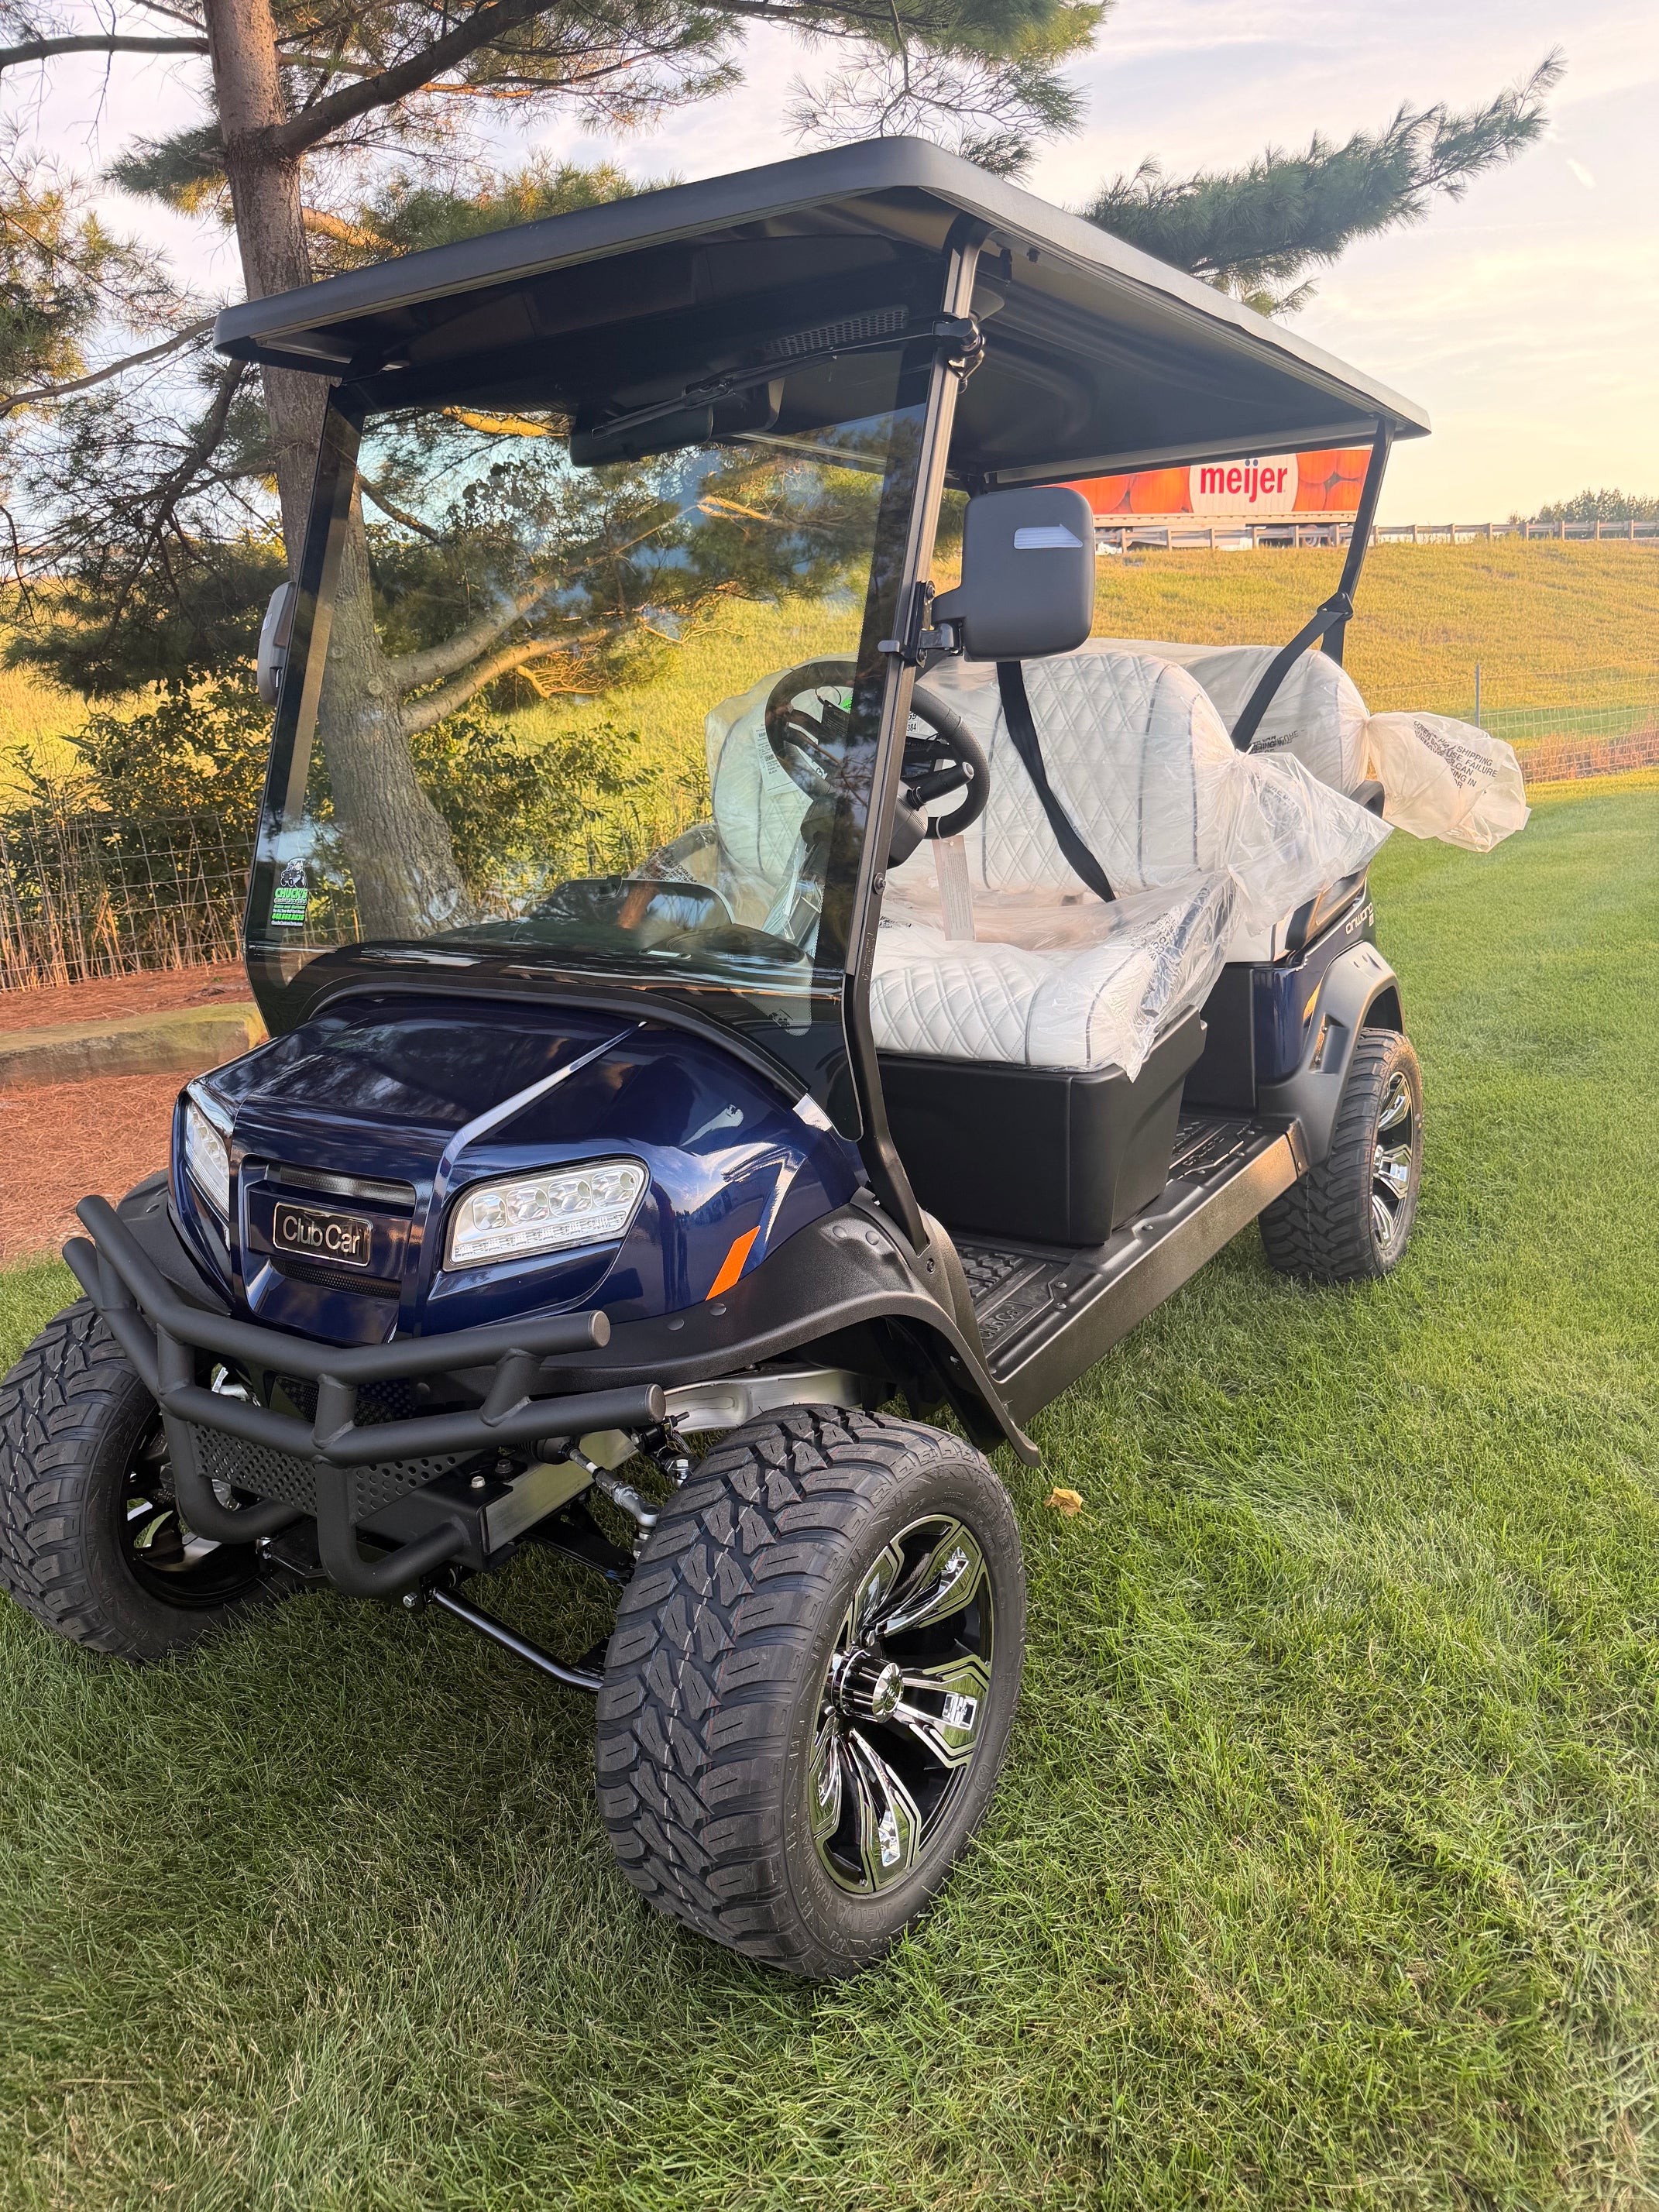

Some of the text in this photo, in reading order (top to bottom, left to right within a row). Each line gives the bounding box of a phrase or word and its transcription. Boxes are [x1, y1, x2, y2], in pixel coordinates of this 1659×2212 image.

[1201, 459, 1288, 503] meijer
[1456, 745, 1493, 767] SHIPPING
[1456, 762, 1474, 776] CAN
[1465, 759, 1499, 778] FAILURE
[1467, 778, 1477, 788] IN
[275, 887, 308, 899] CHUCK'S
[283, 1215, 361, 1255] Club Car
